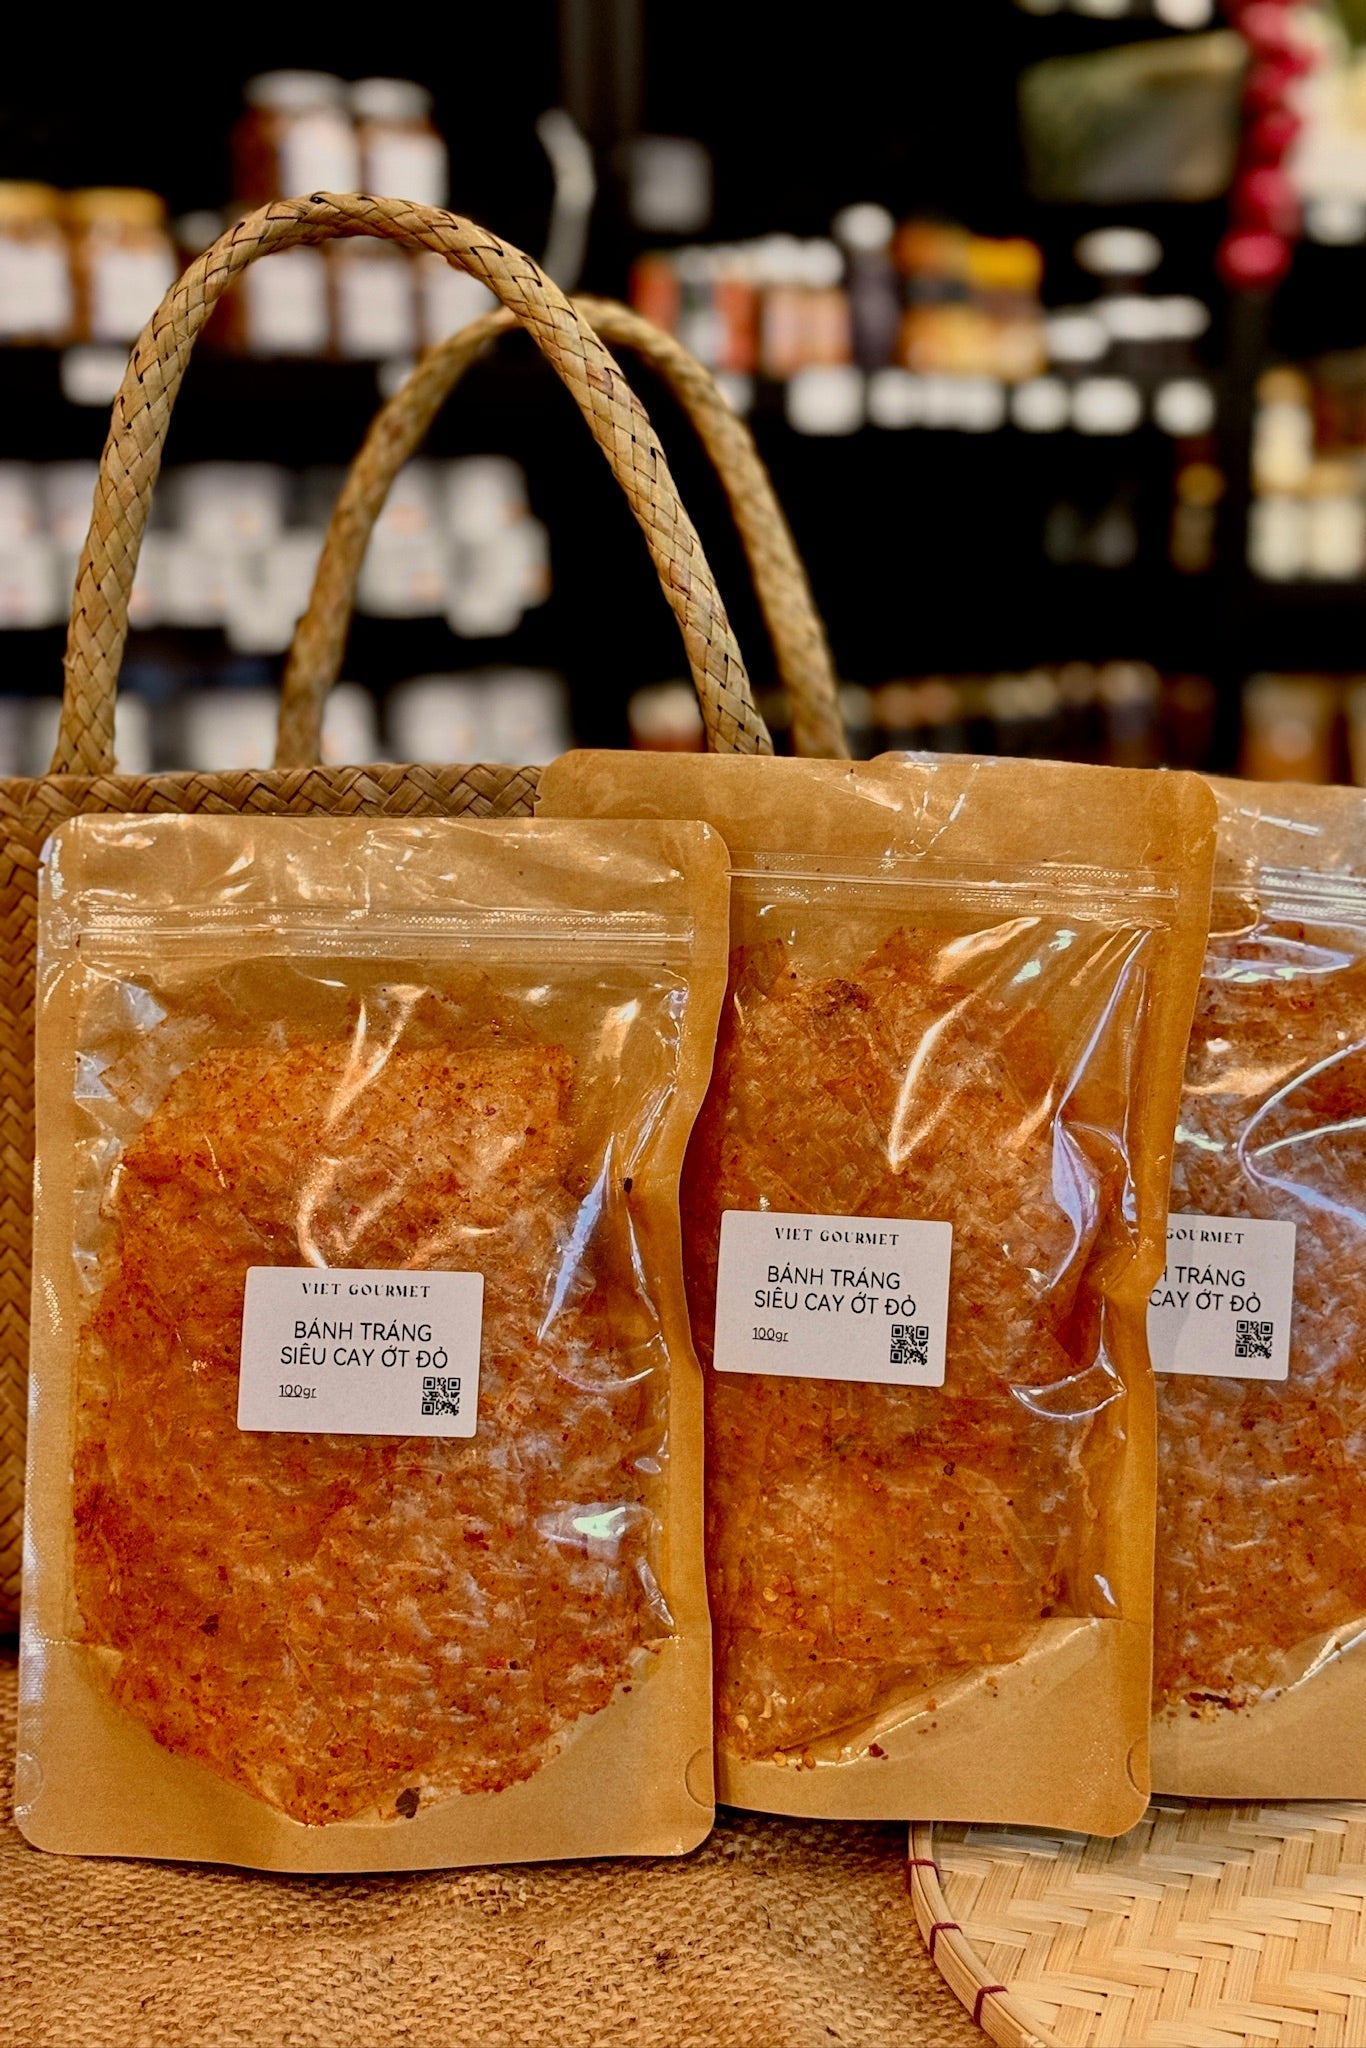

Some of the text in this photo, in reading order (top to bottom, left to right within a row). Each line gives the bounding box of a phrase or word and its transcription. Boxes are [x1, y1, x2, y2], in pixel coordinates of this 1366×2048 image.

[775, 1227, 900, 1246] VIET GOURMET
[1166, 1228, 1245, 1245] GOURMET
[767, 1262, 901, 1290] BÁNH TRÁNG
[1174, 1264, 1246, 1287] TRÁNG
[301, 1282, 431, 1298] VIET GOURMET
[1149, 1288, 1261, 1313] CAY ỚT ĐỎ
[754, 1287, 917, 1317] SIÊU CAY ỚT ĐỎ
[294, 1317, 432, 1342] BÁNH TRÁNG
[752, 1326, 789, 1342] 100gr
[280, 1342, 449, 1369] SIÊU CAY ỚT ĐỎ
[278, 1384, 318, 1399] 100gr
